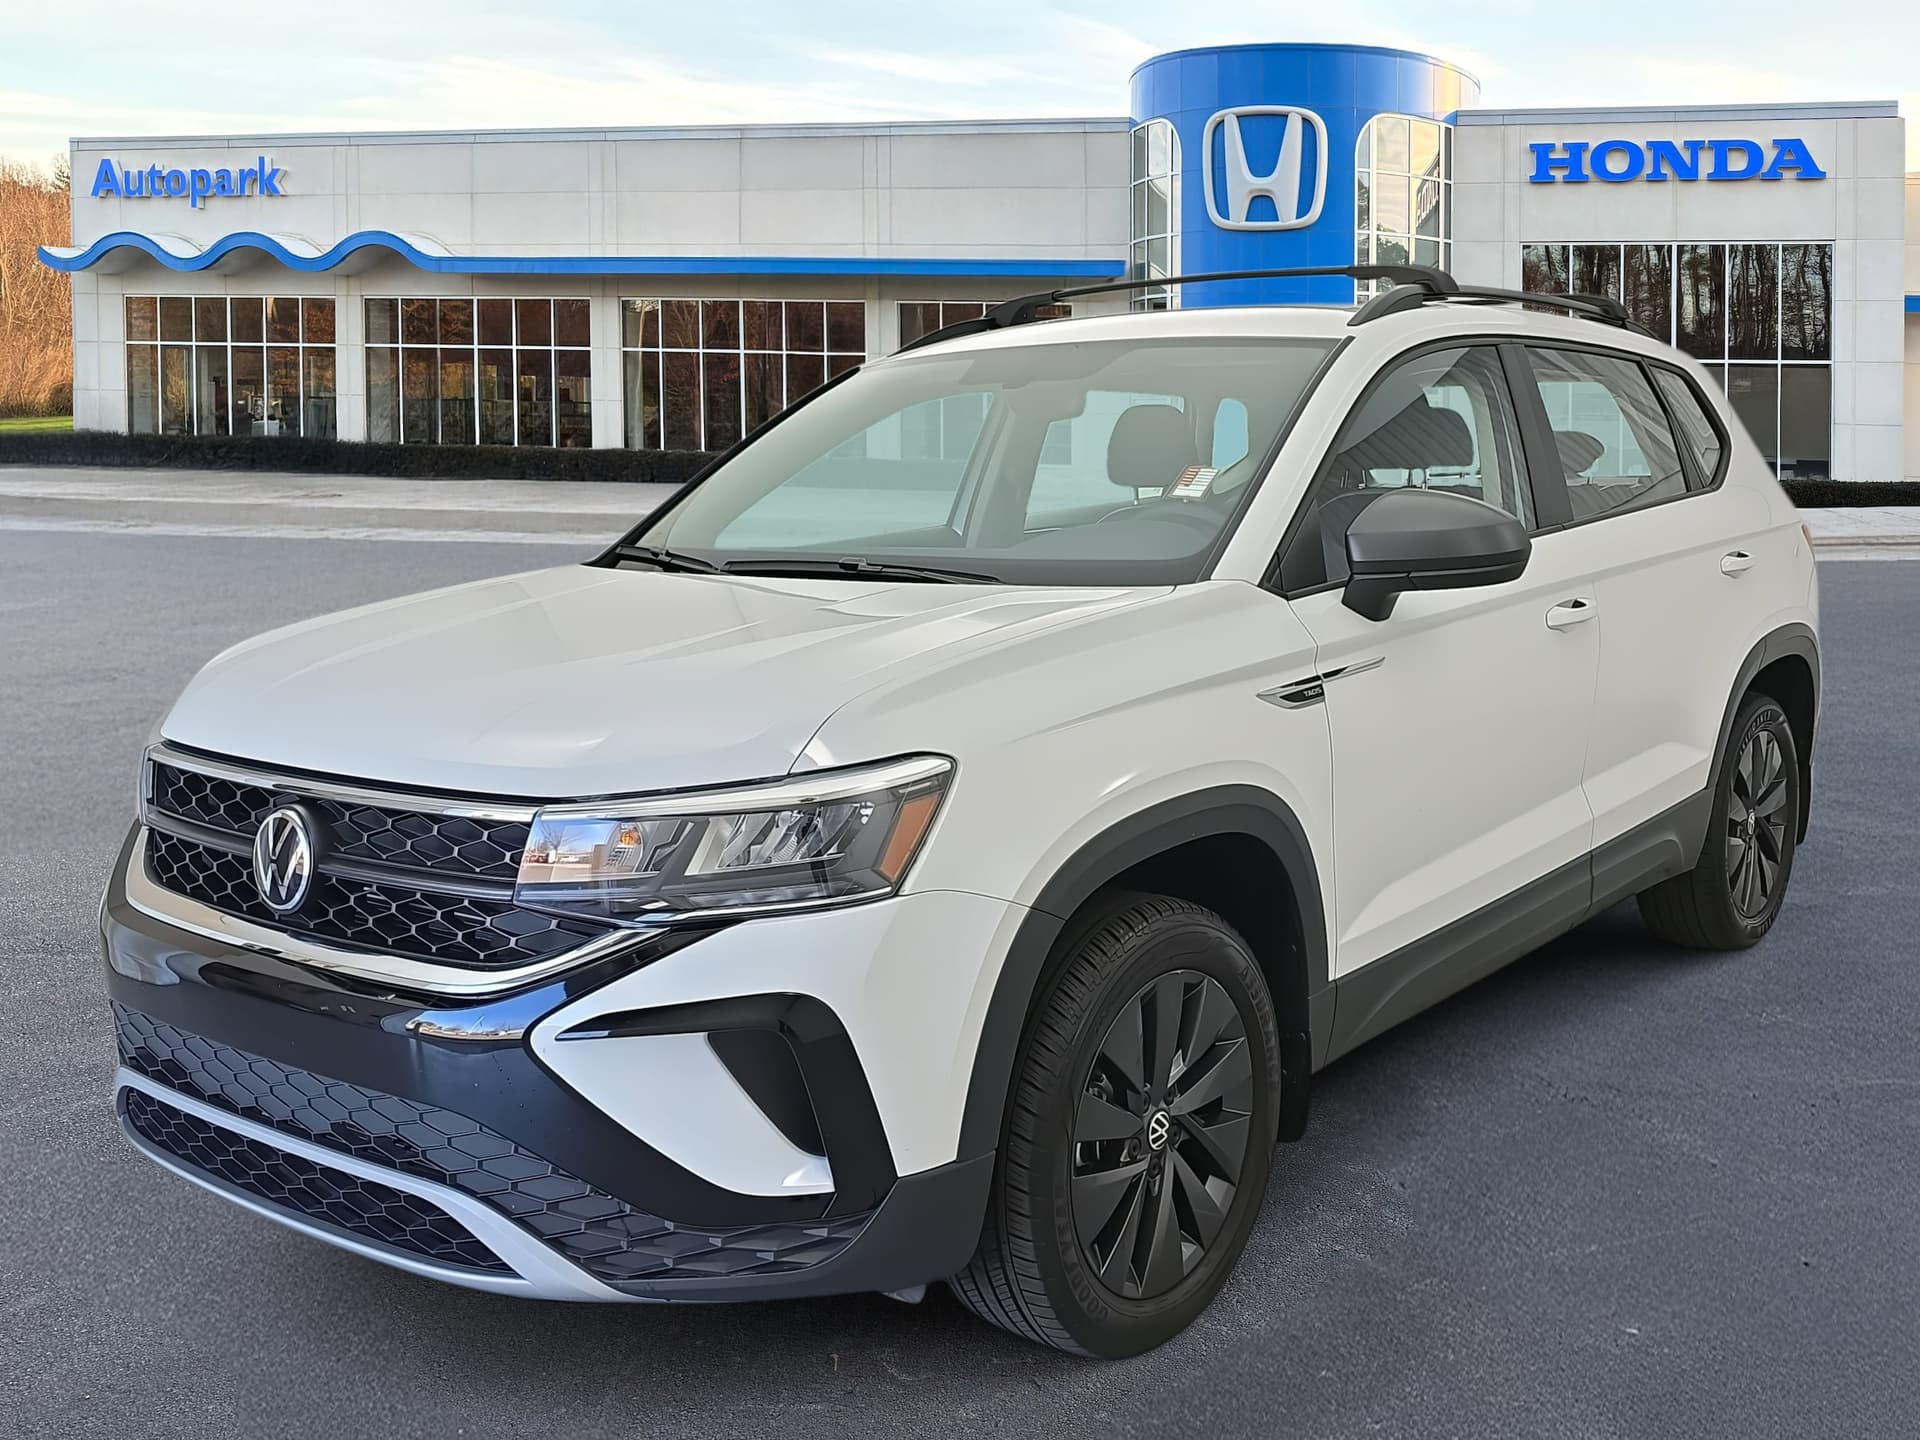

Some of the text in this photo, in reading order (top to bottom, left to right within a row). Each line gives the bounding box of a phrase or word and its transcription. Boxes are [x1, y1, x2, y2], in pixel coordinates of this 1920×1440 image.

[91, 155, 282, 208] Autopark
[1528, 138, 1827, 183] HONDA
[1304, 687, 1322, 696] TAOS
